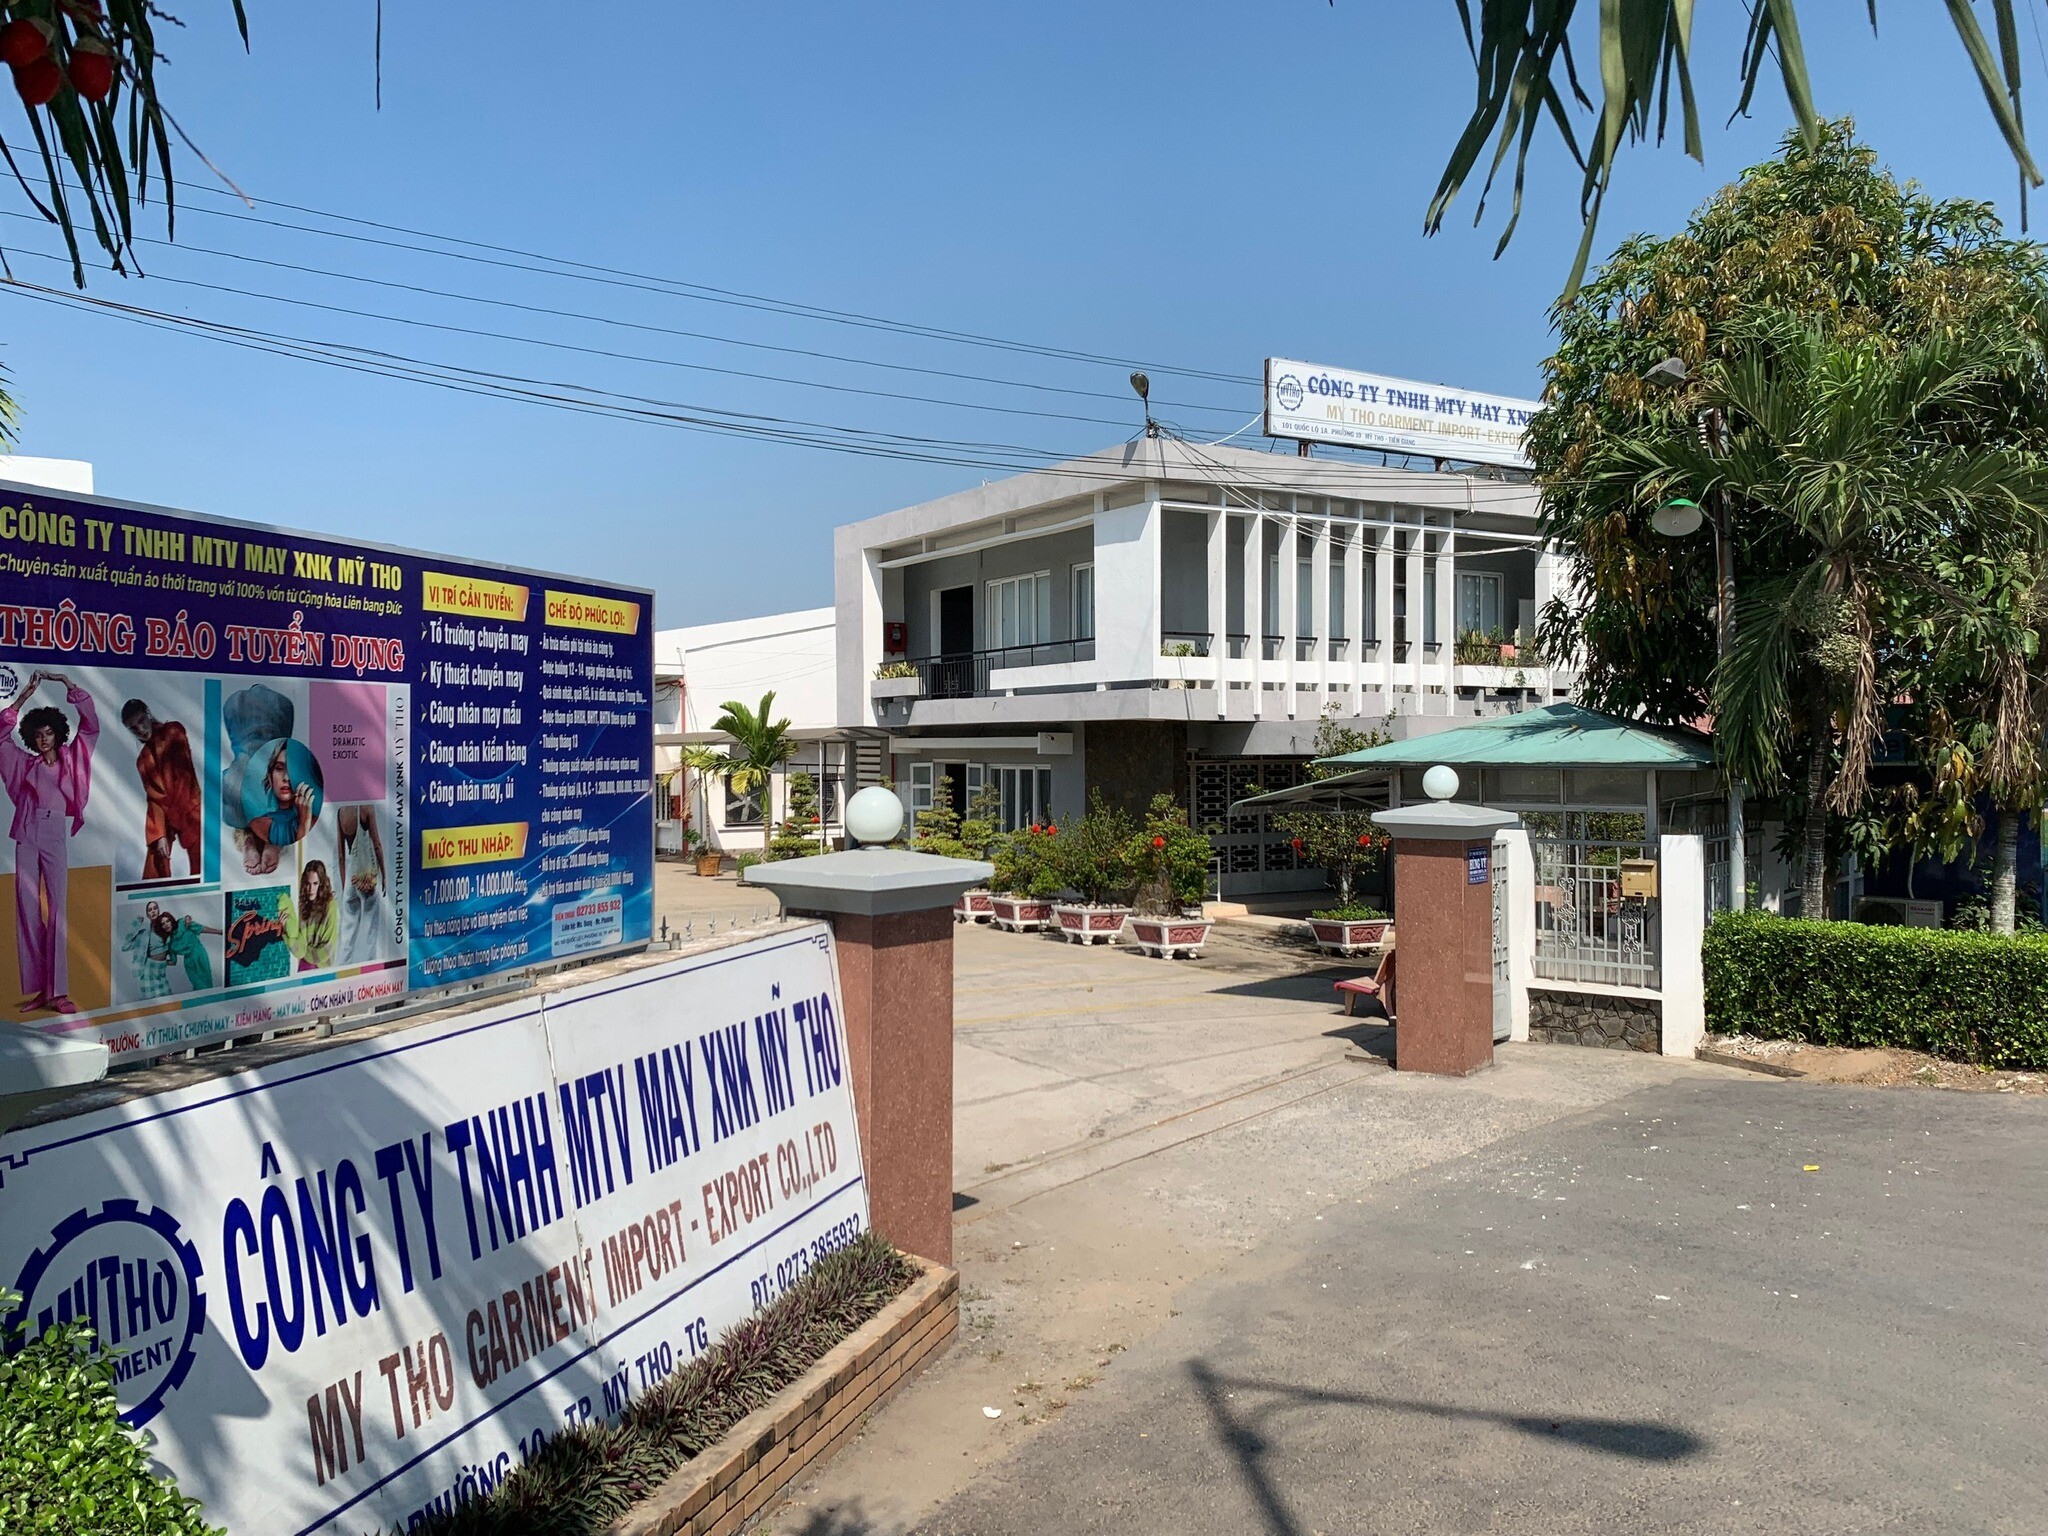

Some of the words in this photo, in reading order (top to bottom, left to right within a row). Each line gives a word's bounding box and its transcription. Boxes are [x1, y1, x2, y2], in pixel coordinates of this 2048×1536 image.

[1308, 373, 1354, 399] CÔNG
[1359, 384, 1379, 403] TY
[1386, 389, 1430, 411] TNHH
[1434, 396, 1466, 416] MTV
[1471, 402, 1501, 422] MAY
[1351, 408, 1375, 425] THO
[1379, 412, 1434, 434] GARMENT
[0, 503, 76, 547] CÔNG
[84, 518, 114, 552] TY
[121, 524, 185, 562] TNHH
[192, 535, 238, 569] MTV
[244, 543, 288, 575] MAY
[293, 550, 333, 582] XNK
[338, 556, 366, 586] MỸ
[370, 563, 402, 592] THO
[0, 553, 50, 577] Chuyên
[53, 559, 76, 578] sản
[79, 561, 108, 582] xuất
[110, 565, 142, 588] quần
[144, 570, 159, 588] áo
[161, 572, 184, 591] thời
[186, 576, 218, 598] trang
[219, 580, 235, 597] với
[237, 582, 265, 600] 100%
[267, 584, 285, 602] vốn
[286, 587, 299, 603] từ
[299, 591, 323, 609] Cộng
[324, 595, 341, 608] hòa
[343, 595, 361, 611] Liên
[362, 598, 384, 617] bang
[385, 600, 403, 616] Đức
[429, 585, 440, 608] VỊ
[442, 584, 457, 605] TRÍ
[459, 582, 481, 608] CẦN
[483, 586, 514, 612] TUYỂN:
[548, 598, 568, 619] CHẾ
[569, 601, 583, 625] ĐỘ
[585, 605, 608, 624] PHÚC
[0, 597, 136, 654] THÔNG
[145, 609, 217, 660] BÁO
[224, 610, 324, 666] TUYỂN
[331, 634, 405, 677] DỤNG
[430, 616, 443, 644] Tổ
[444, 622, 475, 652] trưởng
[477, 625, 509, 654] chuyền
[510, 635, 529, 656] may
[430, 660, 442, 689] Kỹ
[444, 662, 470, 690] thuật
[471, 662, 504, 692] chuyền
[505, 670, 524, 693] may
[332, 724, 353, 733] BOLD
[429, 700, 455, 729] Công
[457, 701, 480, 724] nhân
[482, 707, 501, 729] may
[502, 700, 522, 725] mẫu
[332, 737, 366, 746] DRAMATIC
[332, 750, 359, 759] EXOTIC
[429, 740, 455, 768] Công
[457, 740, 480, 763] nhân
[482, 735, 504, 763] kiểm
[505, 740, 527, 766] hàng
[396, 761, 404, 788] XNK
[429, 780, 454, 807] Công
[457, 779, 480, 802] nhân
[482, 783, 503, 804] may,
[505, 775, 514, 799] ủi
[396, 791, 404, 818] MAY
[396, 821, 404, 848] MTV
[428, 836, 455, 860] MỨC
[458, 838, 478, 857] THU
[481, 832, 513, 857] NHẬP:
[396, 851, 404, 887] TNHH
[396, 890, 404, 905] TY
[433, 875, 470, 904] 7.000.000
[476, 870, 514, 898] 14.000.000
[394, 908, 404, 944] CÔNG
[106, 1030, 140, 1054] TRƯỞNG
[213, 1016, 230, 1031] MAY
[276, 1003, 291, 1018] MAY
[310, 994, 328, 1011] CÔNG
[329, 990, 346, 1007] NHÂN
[357, 985, 374, 1000] CÔNG
[374, 981, 391, 996] NHÂN
[391, 980, 404, 993] MAY
[223, 1141, 381, 1371] CÔNG
[374, 1131, 442, 1295] TY
[444, 1091, 564, 1261] TNHH
[558, 1063, 633, 1210] MTV
[634, 1040, 701, 1174] MAY
[700, 1021, 760, 1144] XNK
[754, 981, 795, 1117] MỸ
[793, 991, 841, 1098] THO
[750, 1273, 775, 1311] ĐT:
[306, 1370, 367, 1487] MY
[378, 1331, 455, 1440] THO
[465, 1247, 597, 1390] GARMENT
[601, 1198, 687, 1309] IMPORT
[701, 1153, 774, 1247] EXPORT
[112, 1337, 173, 1386] MENT
[602, 1358, 630, 1418] MỸ
[635, 1341, 673, 1390] THO
[684, 1317, 709, 1357] TG
